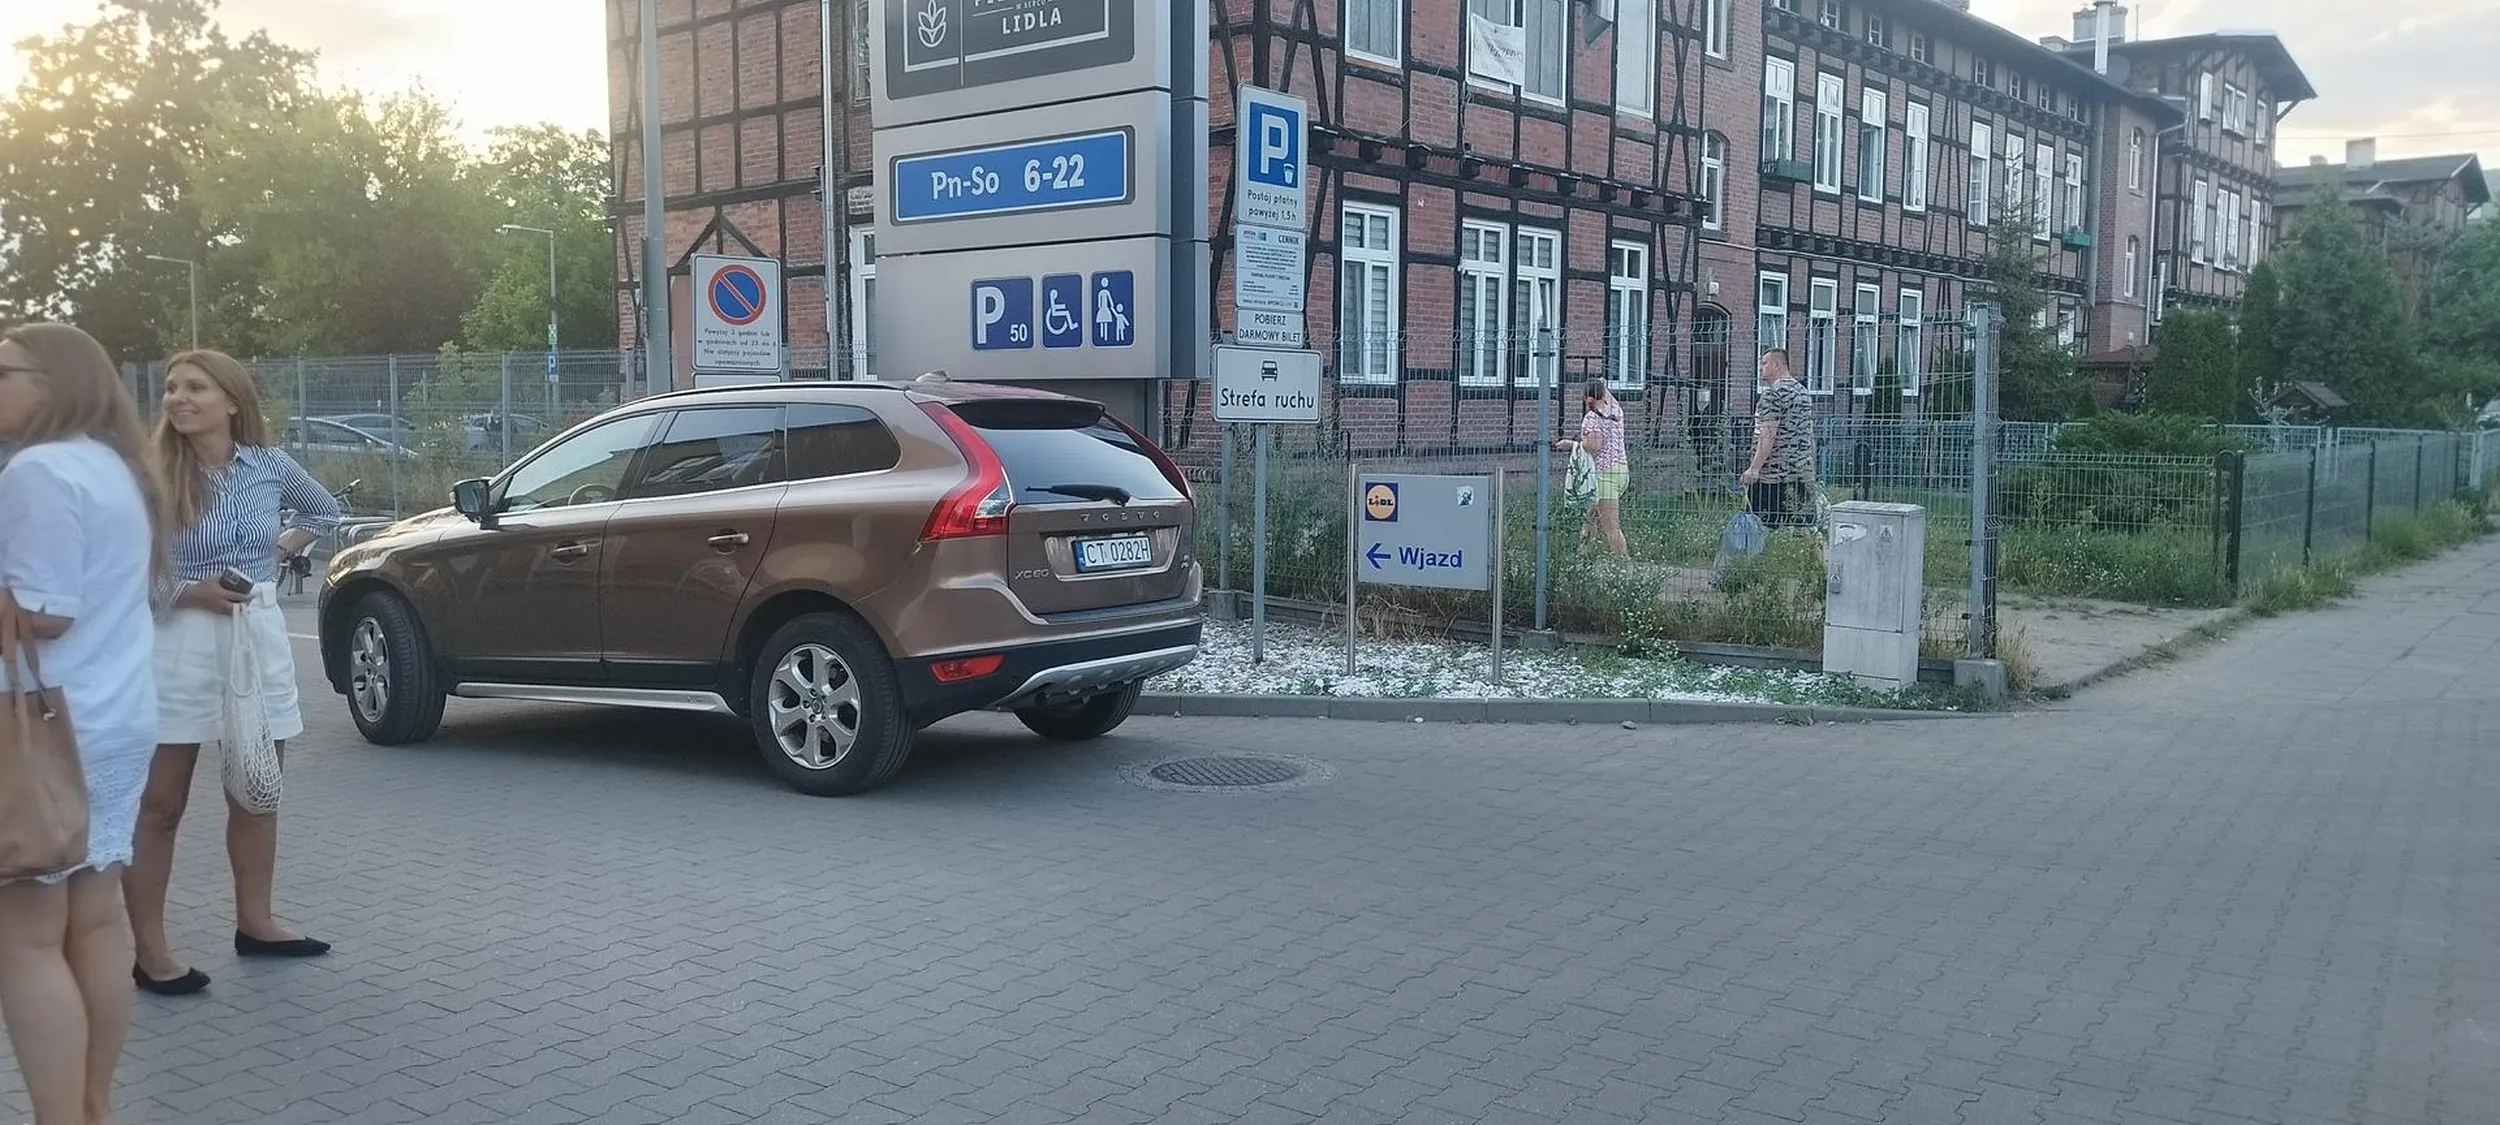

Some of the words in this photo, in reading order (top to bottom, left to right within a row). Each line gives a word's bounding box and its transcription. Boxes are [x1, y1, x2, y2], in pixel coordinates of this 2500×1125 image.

[1002, 7, 1062, 34] LIDLA
[1260, 112, 1289, 174] P
[931, 165, 1000, 199] Pn-So
[1023, 153, 1085, 193] 6-22
[1247, 188, 1272, 204] Postój
[1248, 207, 1280, 221] powyżej
[976, 286, 1005, 344] P
[1009, 323, 1028, 342] 50
[1254, 313, 1286, 326] POBIERZ
[1239, 328, 1280, 341] DARMOWY
[1281, 331, 1301, 342] BILET
[1220, 387, 1266, 408] Strefa
[1275, 390, 1314, 409] ruchu
[1086, 541, 1106, 564] CT
[1110, 538, 1150, 562] 0282H
[1399, 546, 1463, 571] Wjazd
[1014, 568, 1050, 581] XC60
